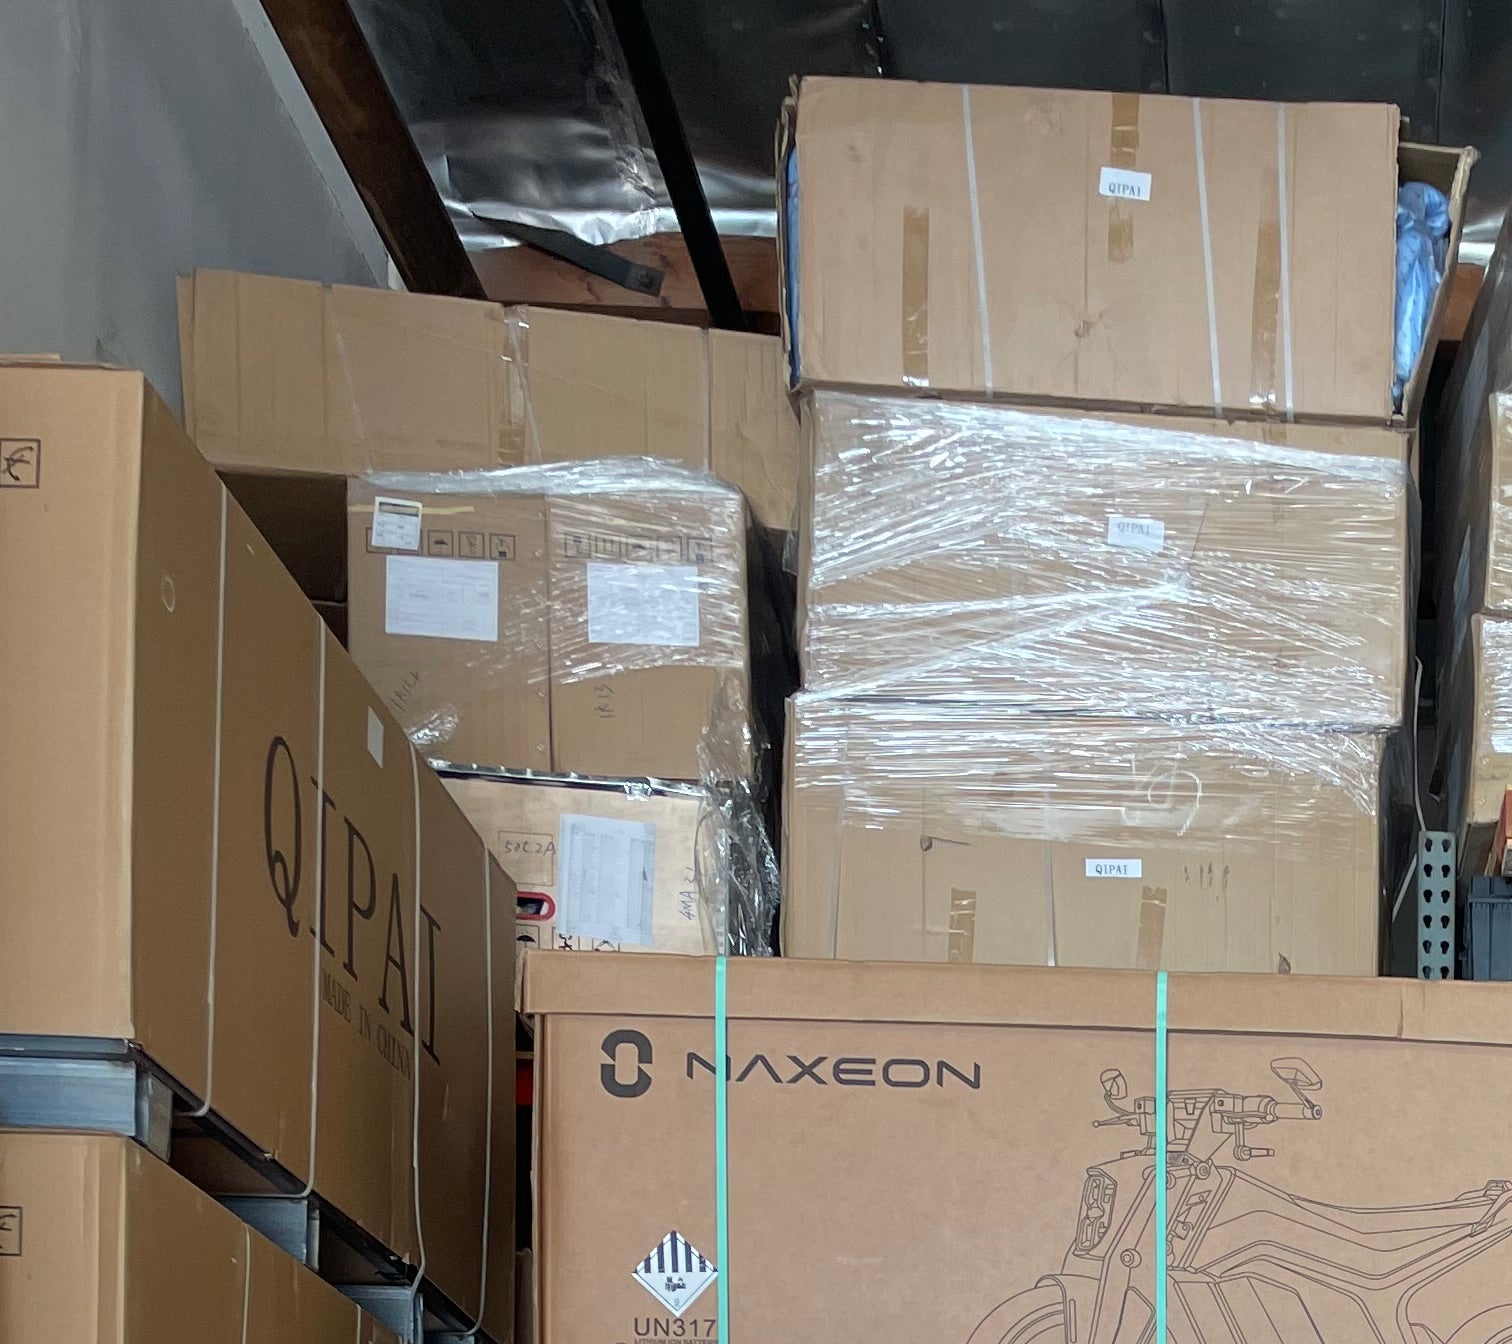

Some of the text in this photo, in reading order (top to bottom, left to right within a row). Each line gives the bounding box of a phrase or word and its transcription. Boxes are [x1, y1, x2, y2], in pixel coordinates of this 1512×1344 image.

[1108, 181, 1143, 198] QIPAI
[1117, 519, 1150, 536] QIPAI
[1095, 863, 1129, 876] QIPAI
[264, 735, 442, 1066] QIPAI
[322, 968, 412, 1081] MADE IN CHINA
[687, 1051, 982, 1091] NAXEON
[634, 1317, 717, 1338] UN317
